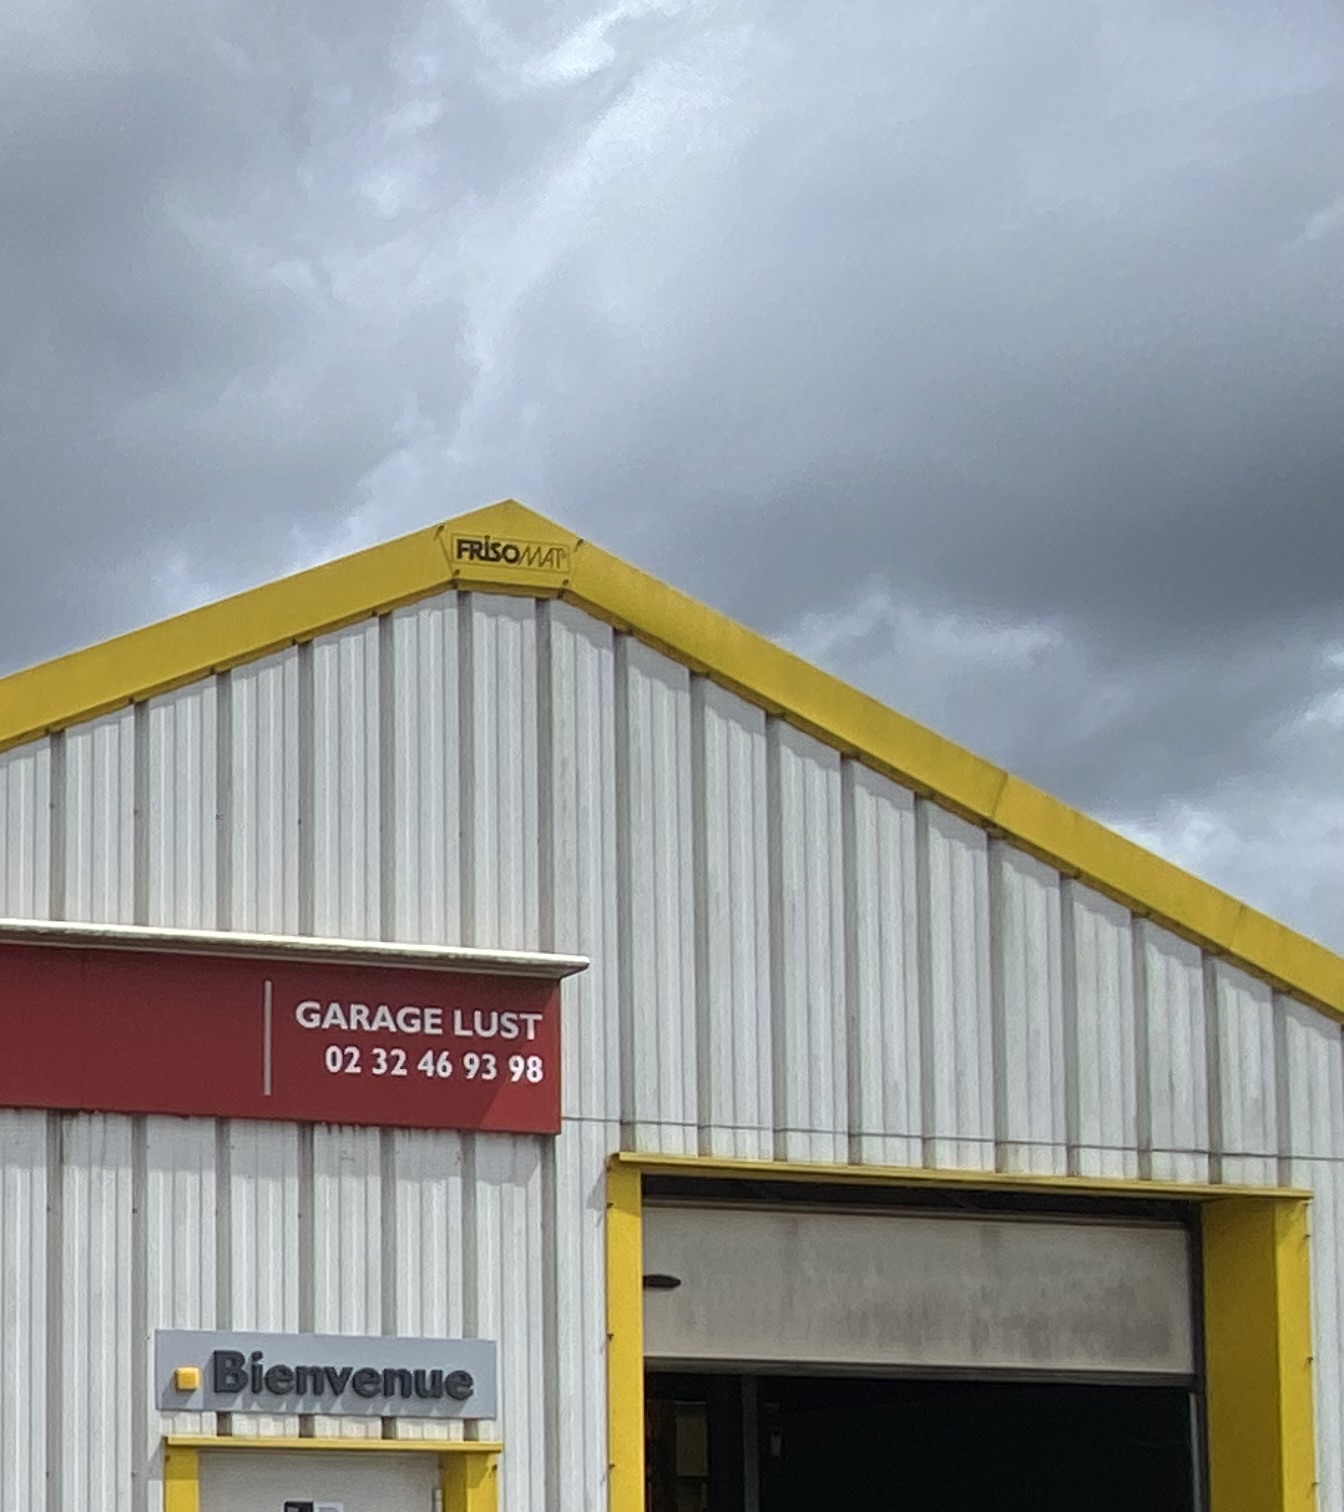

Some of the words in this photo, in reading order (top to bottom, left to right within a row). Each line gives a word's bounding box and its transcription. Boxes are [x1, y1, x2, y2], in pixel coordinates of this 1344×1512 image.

[295, 1000, 443, 1035] GARAGE
[453, 1009, 543, 1041] LUST
[325, 1045, 362, 1074] 02
[371, 1048, 408, 1077] 32
[417, 1050, 453, 1079] 46
[463, 1052, 498, 1081] 93
[508, 1055, 544, 1084] 98
[213, 1350, 475, 1401] Bienvenue
